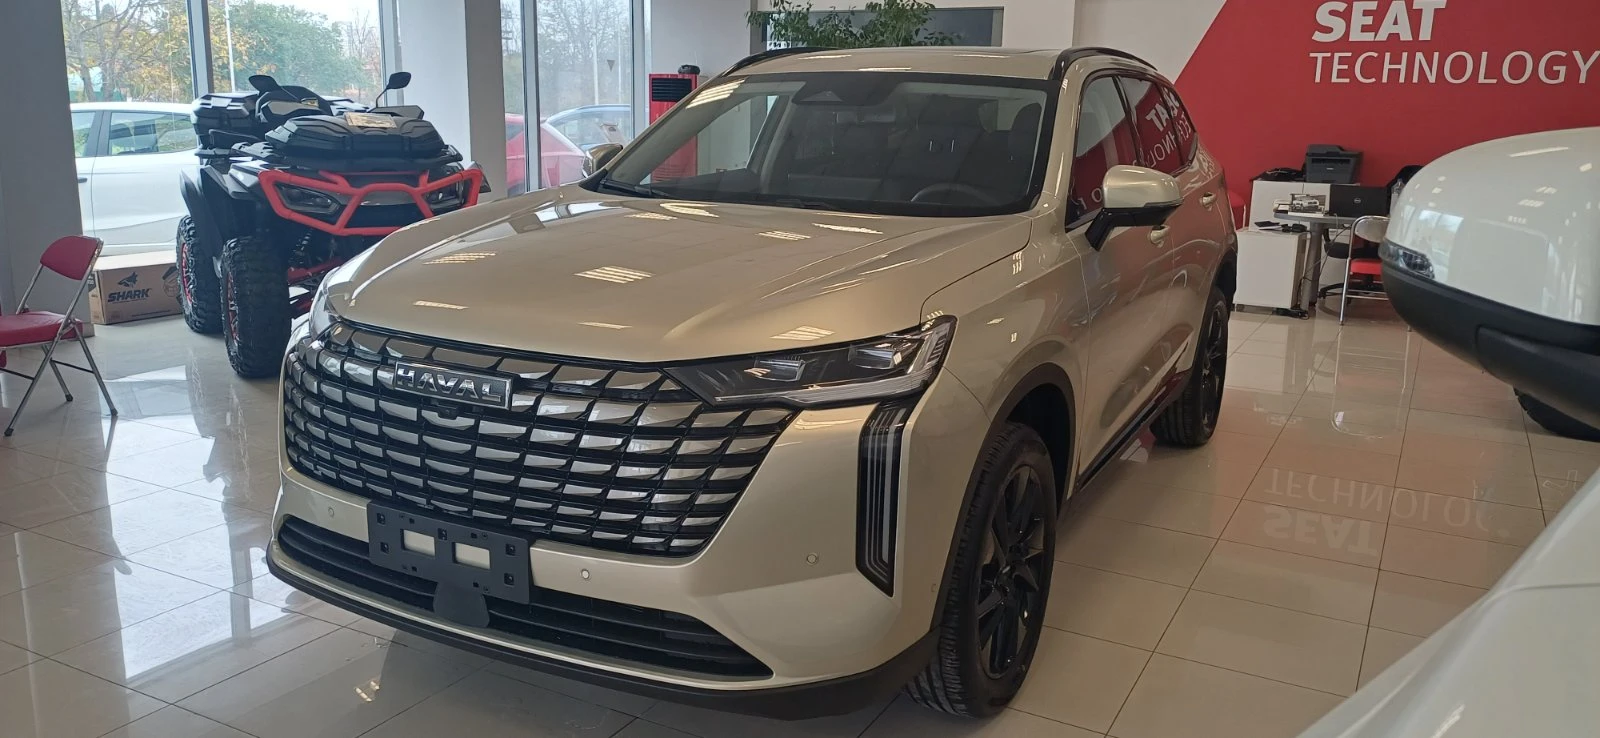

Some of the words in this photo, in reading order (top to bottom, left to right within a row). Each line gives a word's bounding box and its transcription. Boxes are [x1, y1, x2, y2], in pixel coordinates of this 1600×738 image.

[1311, 0, 1447, 43] SEAT
[1309, 50, 1600, 85] TECHNOLOGY
[107, 287, 152, 303] SHARK
[397, 368, 502, 402] HAVAL
